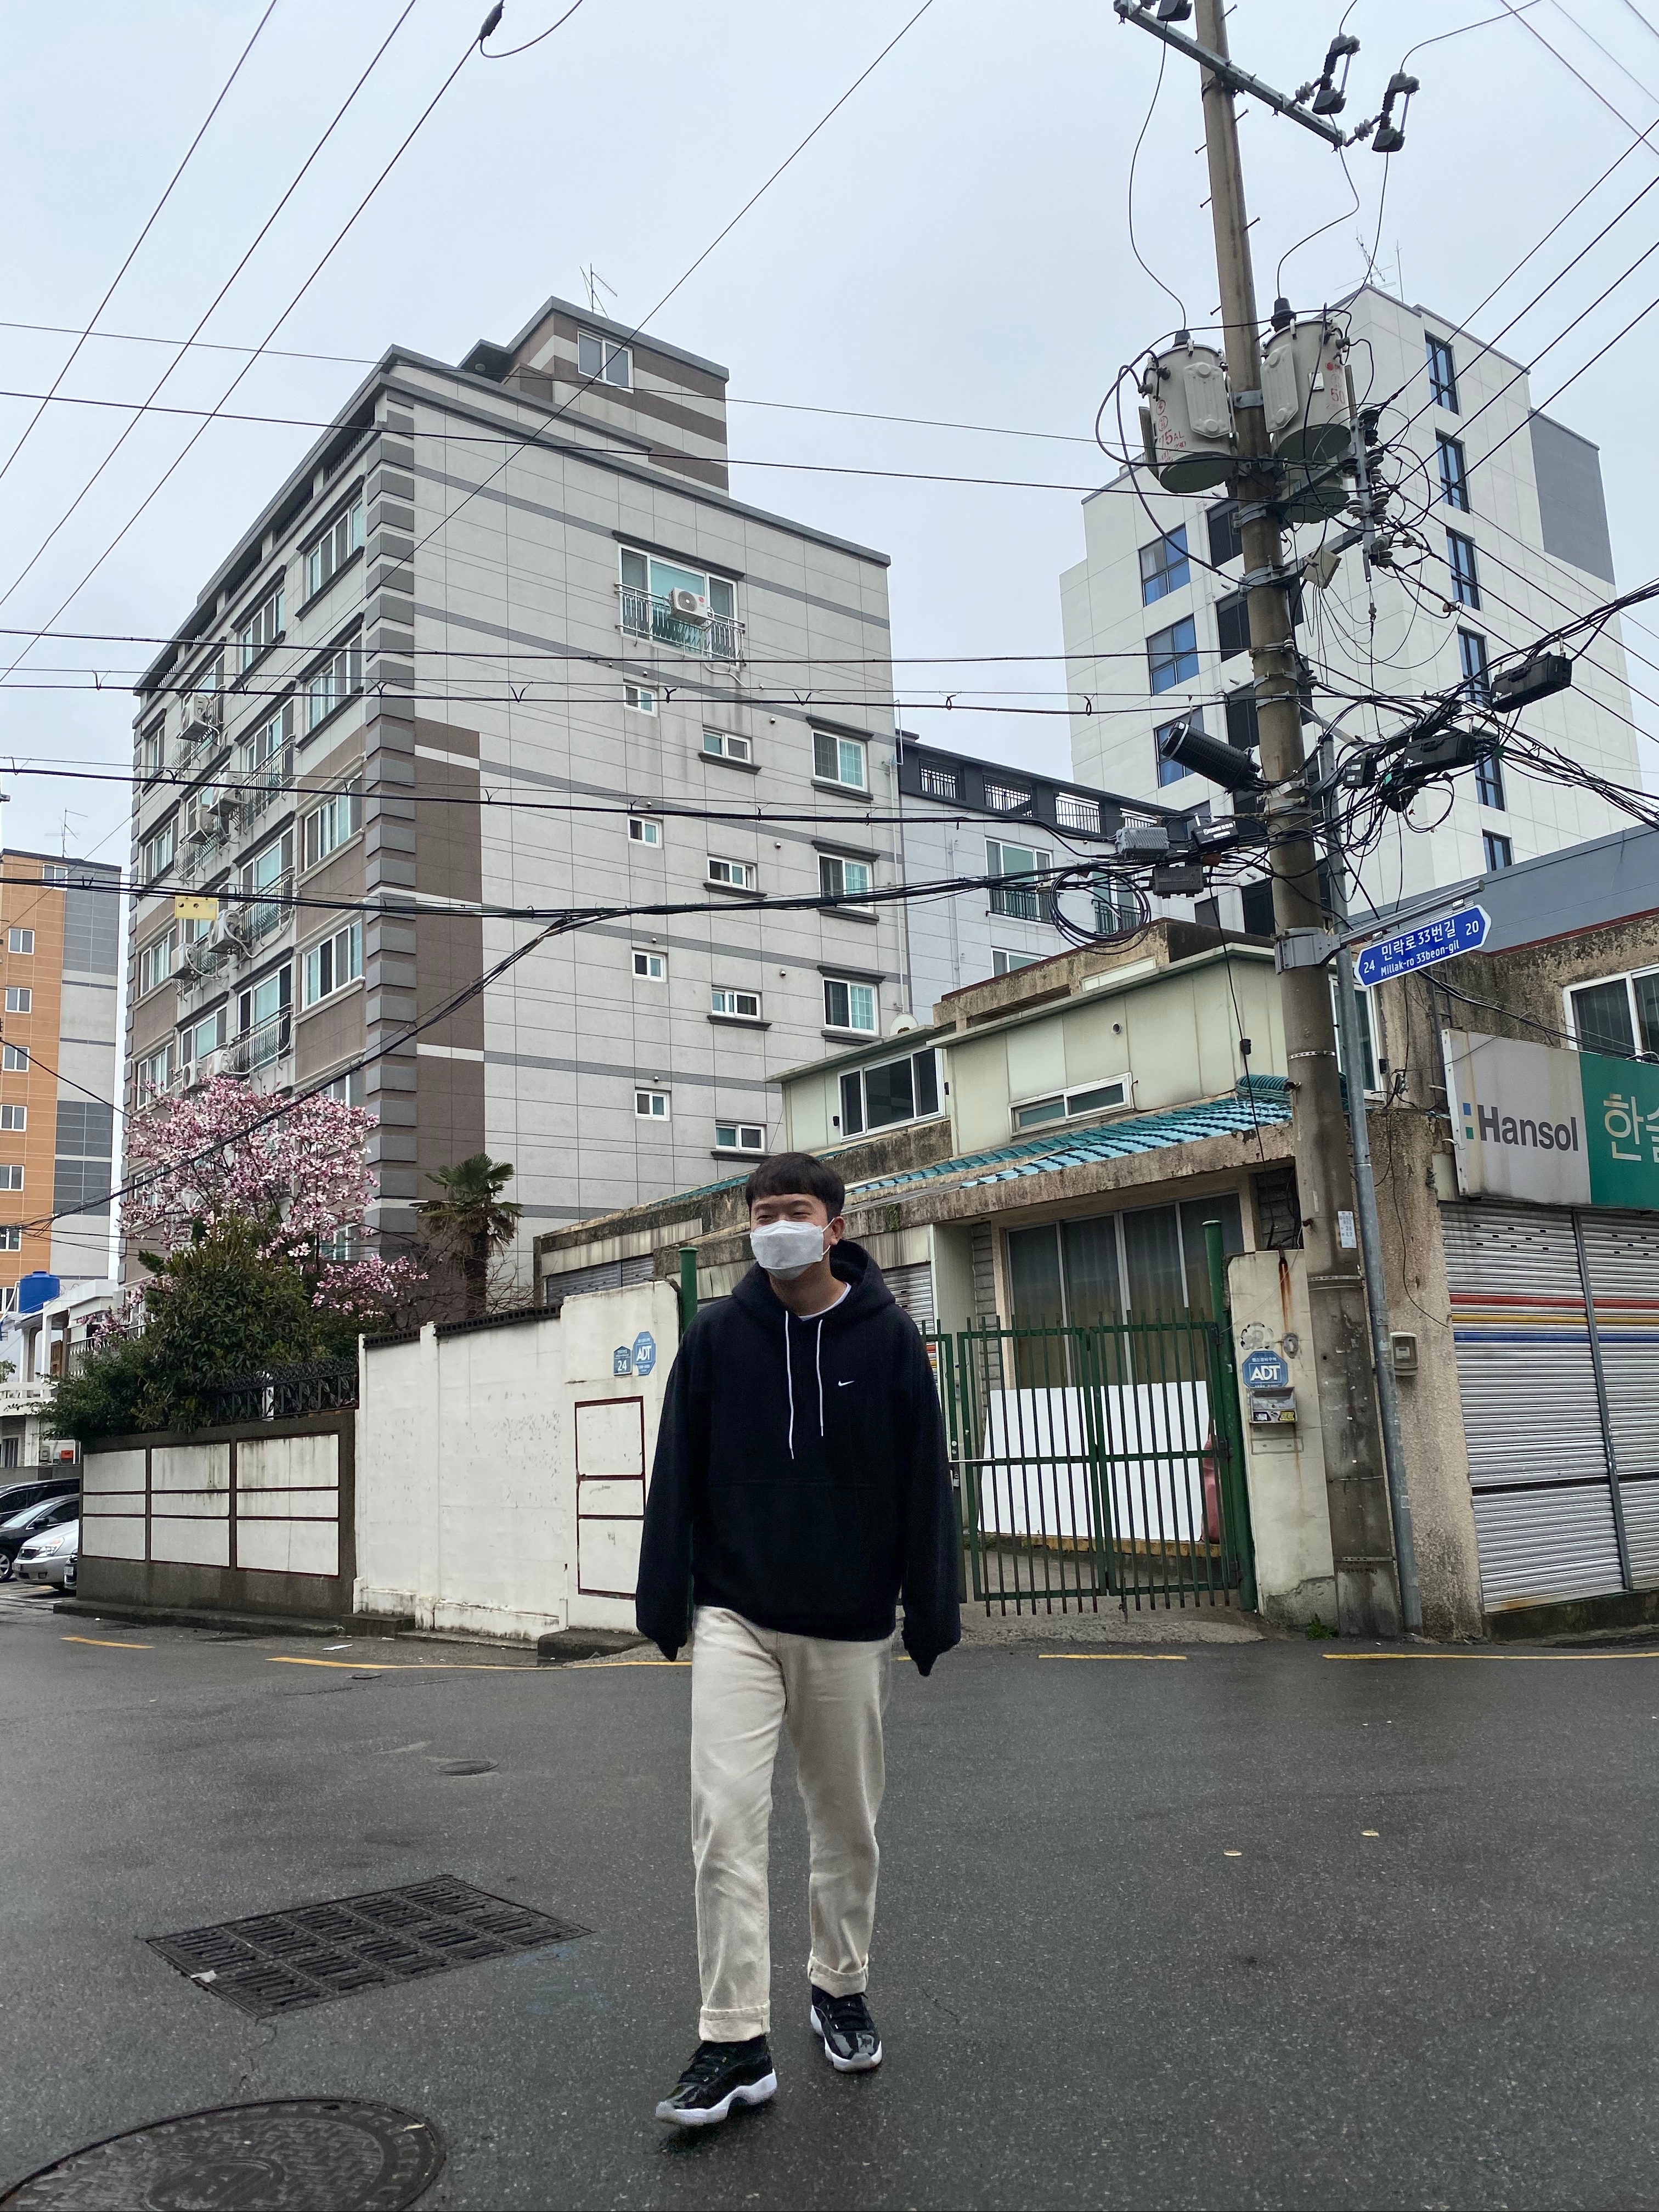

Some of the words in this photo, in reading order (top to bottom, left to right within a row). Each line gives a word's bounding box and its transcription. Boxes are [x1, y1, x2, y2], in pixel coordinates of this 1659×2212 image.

[1465, 920, 1480, 936] 20
[1381, 958, 1414, 977] Millak-ro
[1417, 940, 1459, 963] 33beon-gil
[1363, 960, 1375, 974] 24
[1477, 1104, 1578, 1151] Hansol
[636, 1345, 652, 1361] ADT
[617, 1360, 627, 1371] 24
[1250, 1365, 1280, 1381] ADT
